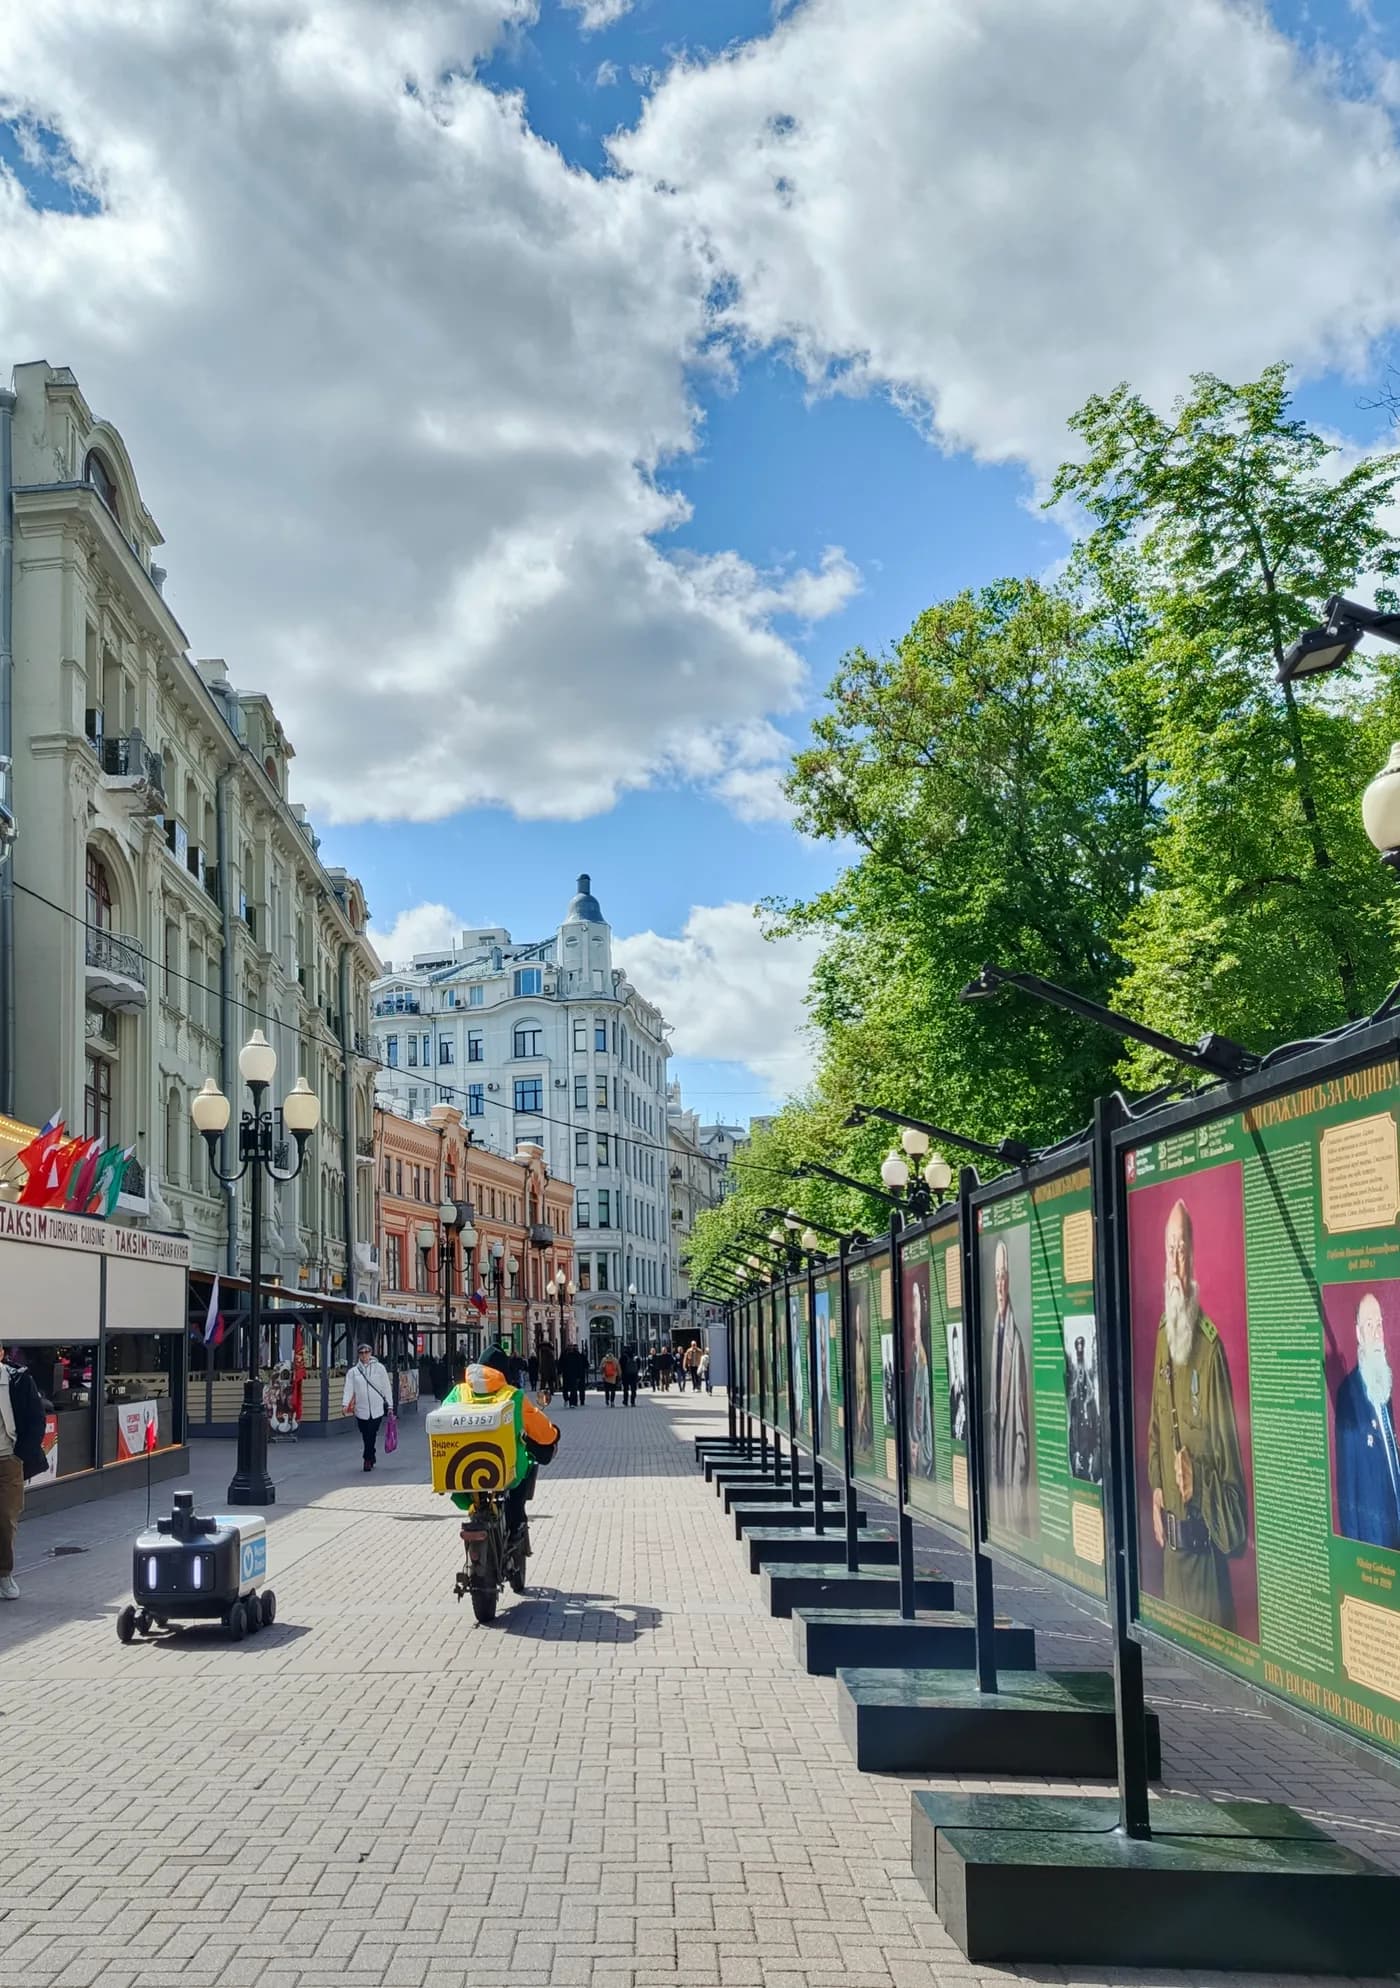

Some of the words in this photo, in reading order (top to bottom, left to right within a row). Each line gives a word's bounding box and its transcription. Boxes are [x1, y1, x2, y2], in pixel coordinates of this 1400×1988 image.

[1263, 1084, 1327, 1128] СРАЖАЛИСЬ
[1327, 1079, 1342, 1106] ЗА
[1343, 1059, 1400, 1102] РОДИНУ!
[0, 1206, 47, 1240] TAKSIM
[49, 1219, 78, 1242] TURKISH
[81, 1225, 105, 1246] CUISINE
[115, 1229, 148, 1256] TAKSIM
[148, 1239, 173, 1259] ТУРЕЦКАЯ
[432, 1440, 459, 1450] Яндекс
[432, 1450, 446, 1458] Еда
[1263, 1660, 1283, 1689] THEY
[1285, 1670, 1320, 1706] FOUGHT
[1323, 1687, 1342, 1717] FOR
[1343, 1696, 1373, 1733] THEIR
